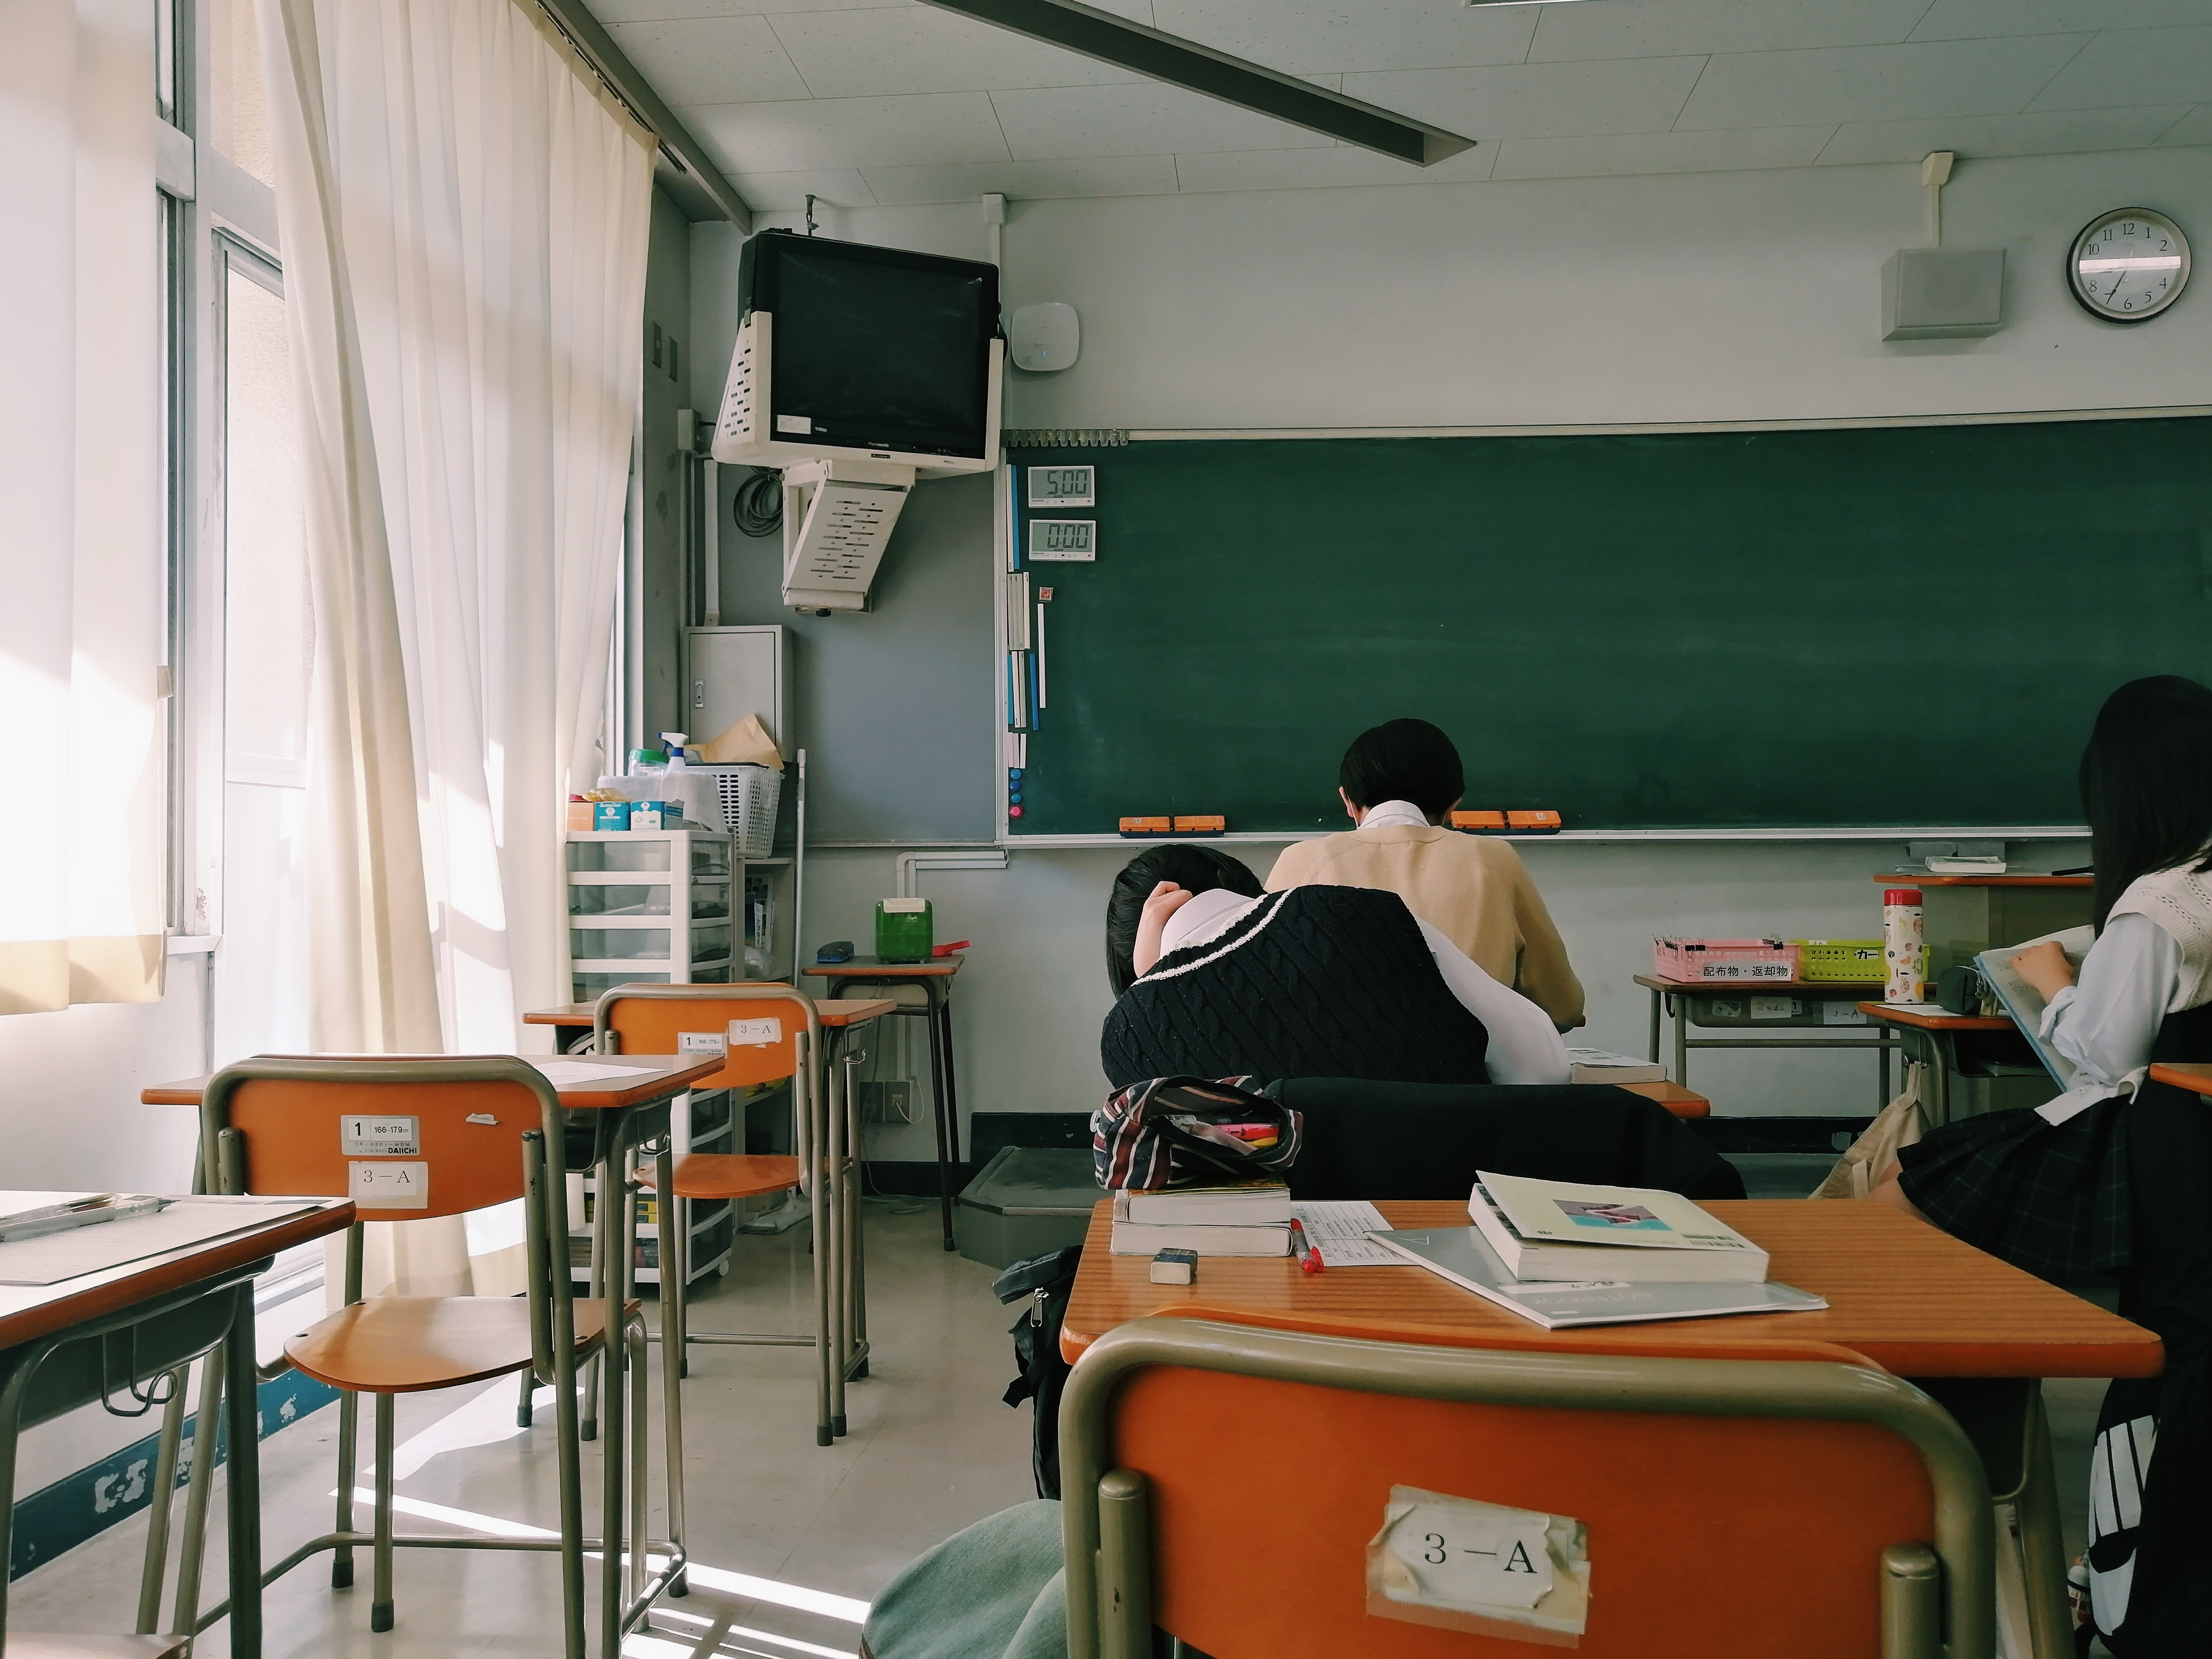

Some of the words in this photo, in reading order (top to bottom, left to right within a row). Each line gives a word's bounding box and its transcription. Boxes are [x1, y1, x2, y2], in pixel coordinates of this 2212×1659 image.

[2103, 229, 2113, 242] 11
[2122, 223, 2135, 236] 12
[2146, 227, 2151, 238] 1
[2087, 243, 2100, 256] 10
[2159, 240, 2168, 252] 2
[2089, 280, 2097, 292] 8
[2159, 277, 2167, 289] 4
[2124, 297, 2132, 310] 6
[2144, 291, 2152, 304] 5
[1046, 470, 1088, 495] 5:00
[1047, 524, 1089, 549] 0:00
[1703, 965, 1788, 977] 配布物・返却物
[687, 1036, 691, 1046] 1
[355, 1122, 361, 1136] 1
